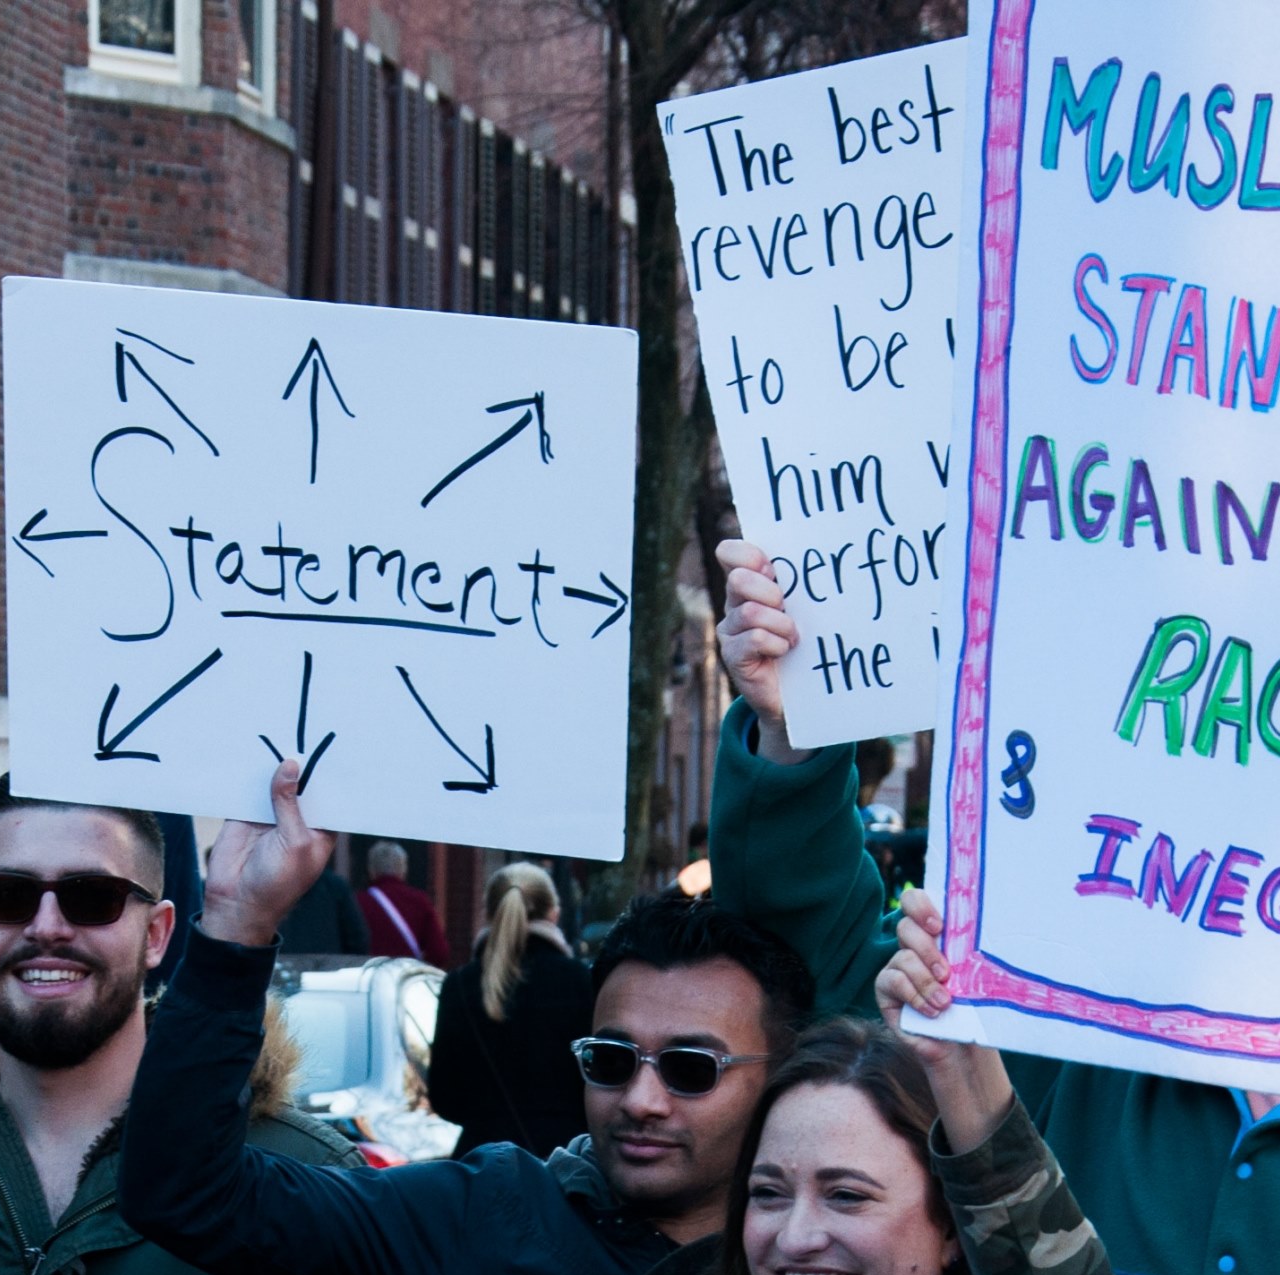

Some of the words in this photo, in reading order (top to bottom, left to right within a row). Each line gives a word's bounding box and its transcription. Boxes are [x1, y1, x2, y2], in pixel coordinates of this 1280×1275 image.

[828, 65, 955, 165] best
[691, 192, 954, 311] revenge
[725, 336, 784, 414] to
[834, 305, 908, 393] be
[766, 438, 895, 525] him
[91, 426, 559, 648] Statement
[812, 632, 893, 695] the
